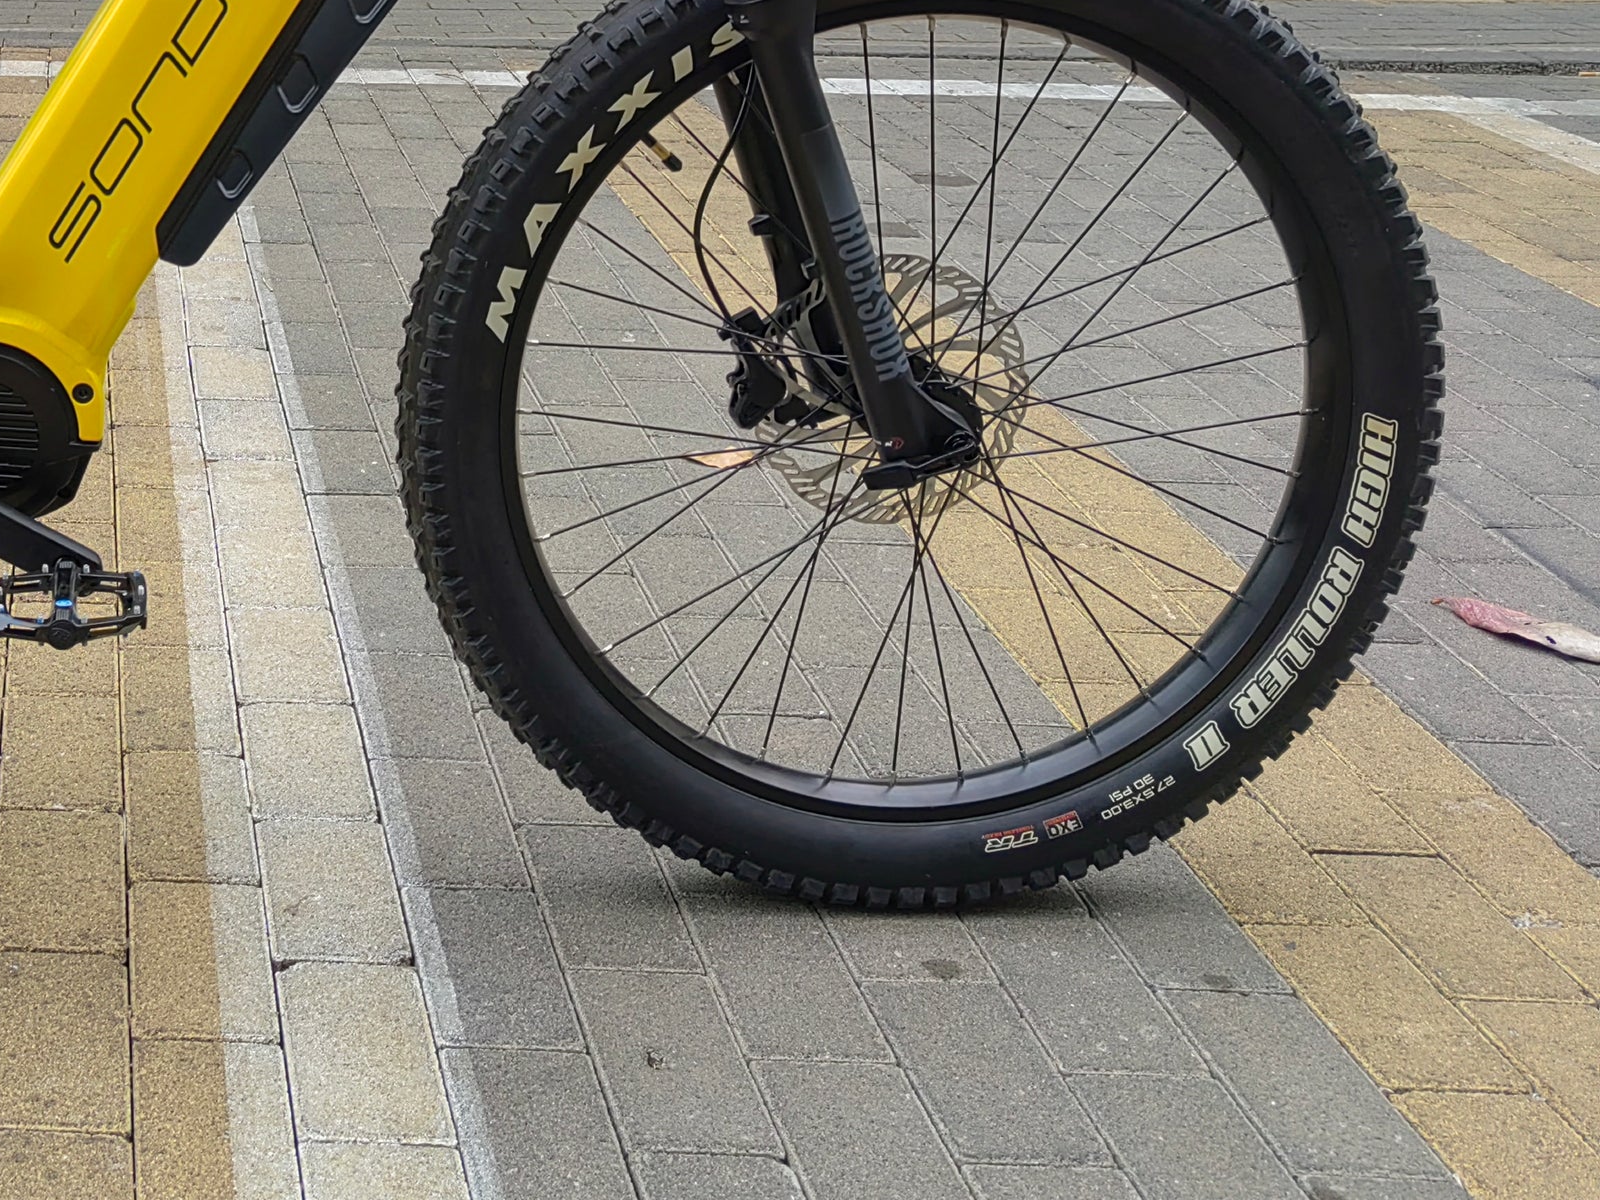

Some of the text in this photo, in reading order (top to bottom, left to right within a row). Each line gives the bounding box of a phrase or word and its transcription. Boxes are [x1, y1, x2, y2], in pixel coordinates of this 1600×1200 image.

[485, 22, 746, 343] MAXXIS
[830, 209, 911, 383] ROCKSHOX
[1341, 412, 1398, 548] HIGH
[1230, 546, 1364, 729] ROLLER
[1047, 816, 1082, 838] EXO
[1101, 775, 1176, 820] 27.5X3.00
[1109, 774, 1155, 803] 30 PSI
[984, 830, 1038, 853] TR
